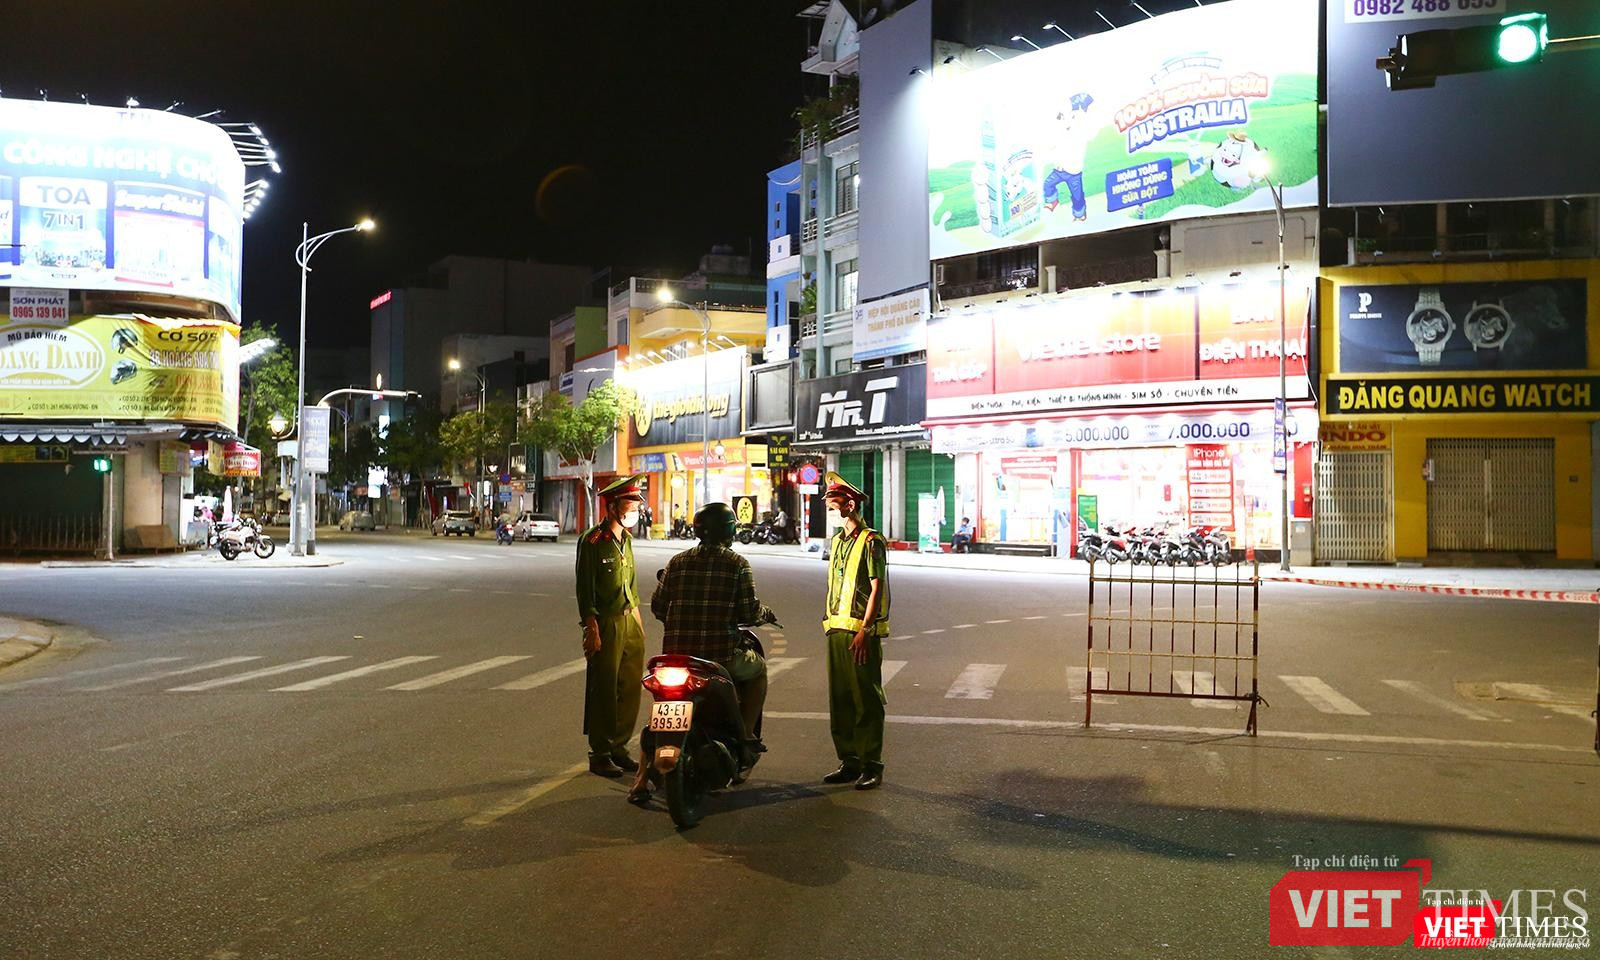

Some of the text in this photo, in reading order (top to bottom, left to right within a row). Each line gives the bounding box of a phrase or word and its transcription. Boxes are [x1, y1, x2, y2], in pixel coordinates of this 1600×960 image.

[1129, 98, 1248, 152] AUSTRALIA
[1138, 163, 1159, 177] TOÀN
[1112, 171, 1168, 194] KHÔNG DÙNG
[37, 185, 92, 205] TOA
[1141, 186, 1159, 200] BỘT
[36, 307, 50, 319] 139
[1200, 337, 1246, 364] ĐIỆN
[1103, 392, 1122, 401] MINH
[1132, 391, 1147, 400] SIM
[1338, 380, 1591, 410] ĐĂNG QUANG WATCH
[652, 717, 689, 730] 395.34
